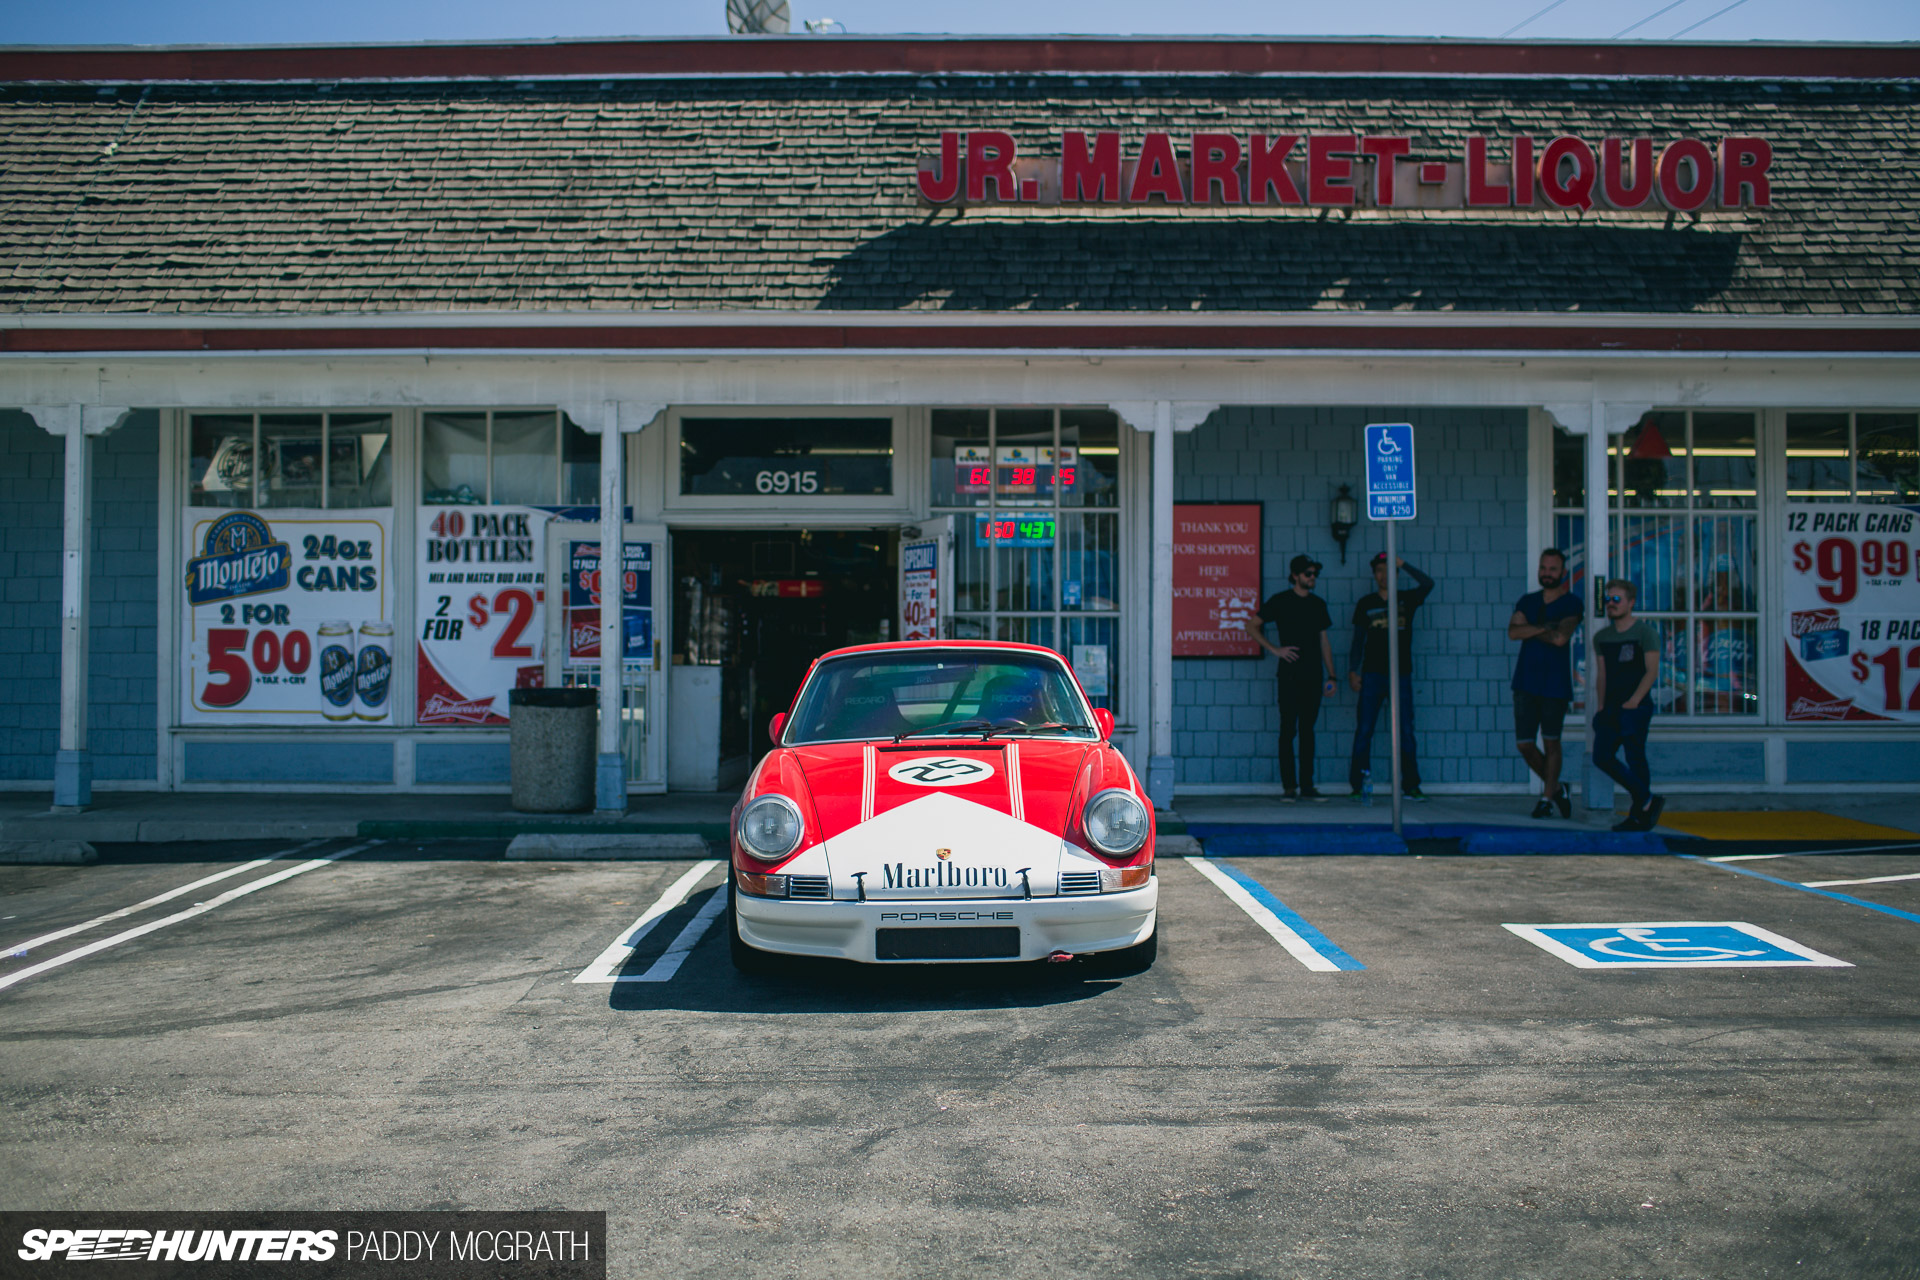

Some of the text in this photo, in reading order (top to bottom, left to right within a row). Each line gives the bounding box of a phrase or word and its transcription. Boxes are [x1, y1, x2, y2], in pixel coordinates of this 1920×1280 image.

[918, 131, 1040, 204] JR.
[1060, 132, 1410, 206] MARKET
[1465, 136, 1773, 213] LIQUOR
[1377, 455, 1403, 464] PARKING
[1011, 468, 1036, 485] 38
[1383, 465, 1397, 473] ONLY
[755, 470, 818, 494] 6915
[1373, 482, 1409, 490] ACCESSIBLE
[1377, 495, 1407, 504] MINIMUM
[1373, 505, 1411, 515] FINE $250
[430, 510, 530, 537] 40 PACK
[1020, 521, 1055, 538] 437
[1180, 522, 1248, 533] THANK YOU
[1788, 512, 1914, 533] 12 PACK CANS
[303, 534, 373, 560] 24oz
[426, 539, 534, 563] BOTTLES!
[1173, 544, 1256, 555] FOR SHOPPING
[197, 549, 279, 591] Montejo
[581, 560, 597, 569] PACK
[1199, 566, 1229, 577] HERE
[296, 566, 378, 591] CANS
[429, 572, 446, 584] MIX
[447, 572, 464, 584] AND
[466, 572, 495, 584] MATCH
[496, 572, 514, 584] BUD
[515, 572, 534, 584] AND
[911, 589, 923, 600] For
[1173, 587, 1257, 598] YOUR BUSINESS
[220, 603, 290, 625] 2 FOR
[435, 595, 452, 617] 2
[1209, 609, 1219, 619] IS
[422, 619, 465, 641] FOR
[467, 587, 544, 660] $2
[1861, 620, 1882, 640] 18
[425, 699, 489, 715] Budweiser
[845, 695, 1032, 705] RECARO RECARO
[898, 759, 983, 782] 25
[881, 861, 1007, 889] Marlboro
[881, 911, 1013, 922] PORSCHE
